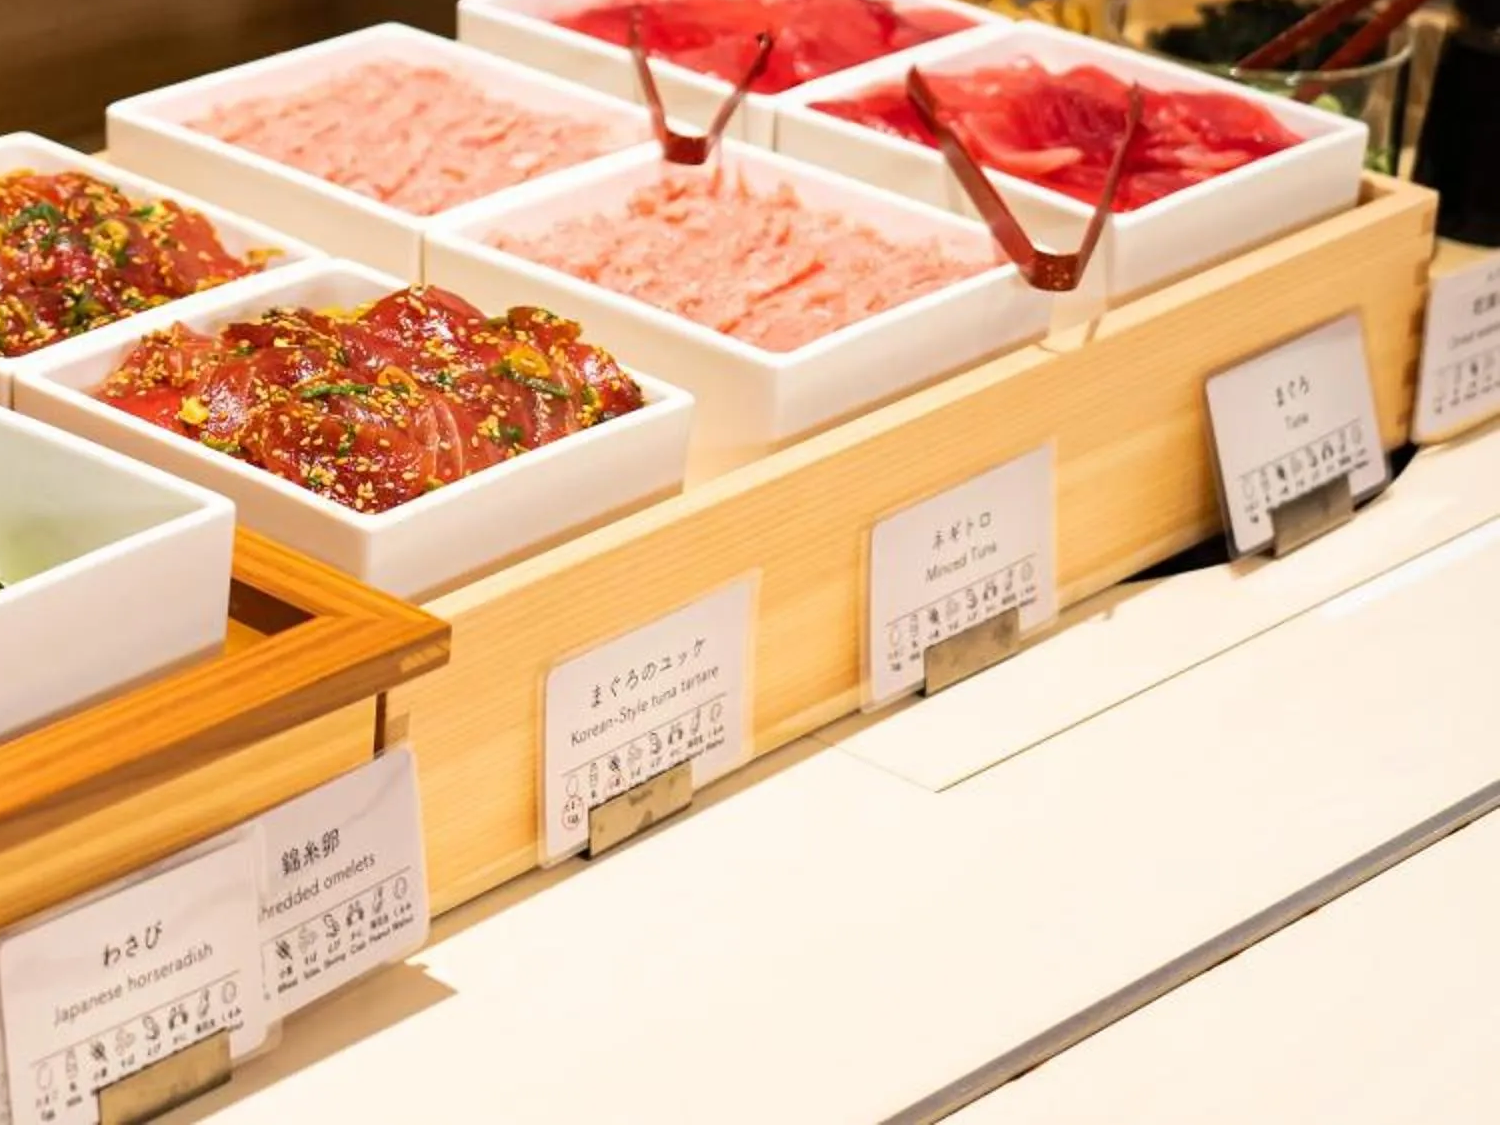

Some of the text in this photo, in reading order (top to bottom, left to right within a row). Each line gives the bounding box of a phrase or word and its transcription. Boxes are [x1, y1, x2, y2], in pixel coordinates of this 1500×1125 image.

[932, 512, 992, 550] ネギトロ
[925, 540, 997, 583] Minced Tuna
[590, 637, 706, 708] まぐろのユッケ
[570, 695, 649, 747] Korean-Style
[651, 684, 678, 709] tuna
[680, 666, 720, 696] tartare
[281, 827, 340, 876] 錦糸卵
[257, 853, 376, 923] hredded omelets
[102, 920, 163, 968] わさび
[53, 942, 214, 1026] Japanese horseradish
